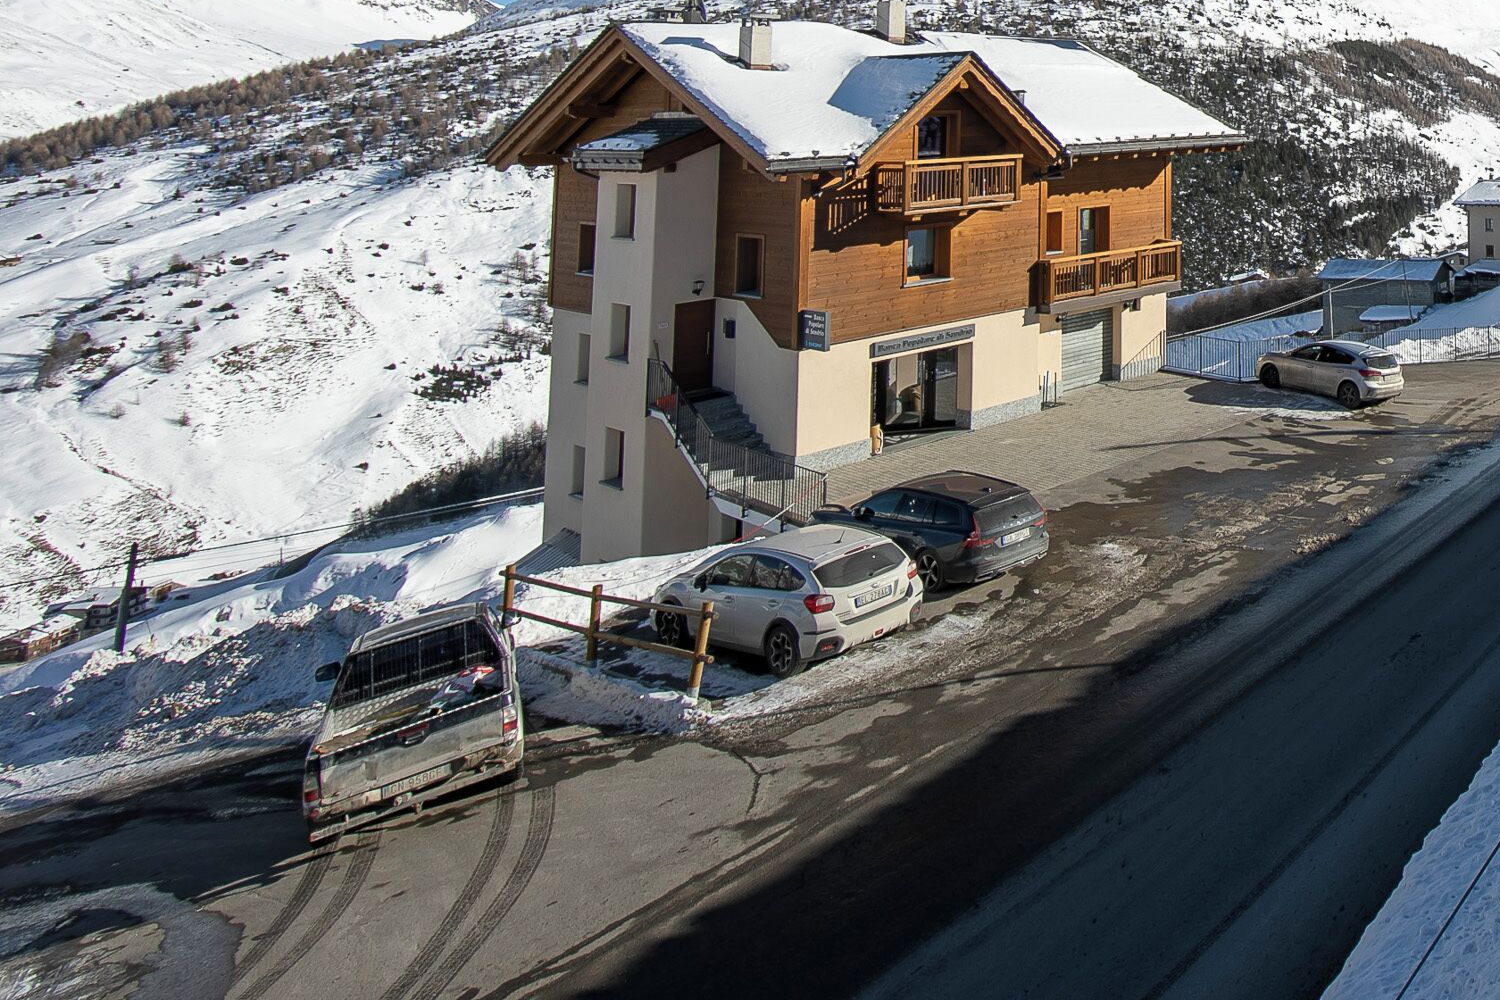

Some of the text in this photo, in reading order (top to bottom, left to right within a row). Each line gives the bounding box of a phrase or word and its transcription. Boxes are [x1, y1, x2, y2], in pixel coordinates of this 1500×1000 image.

[808, 320, 825, 329] Popolare
[877, 327, 973, 353] Banca Popolare di Sondrio
